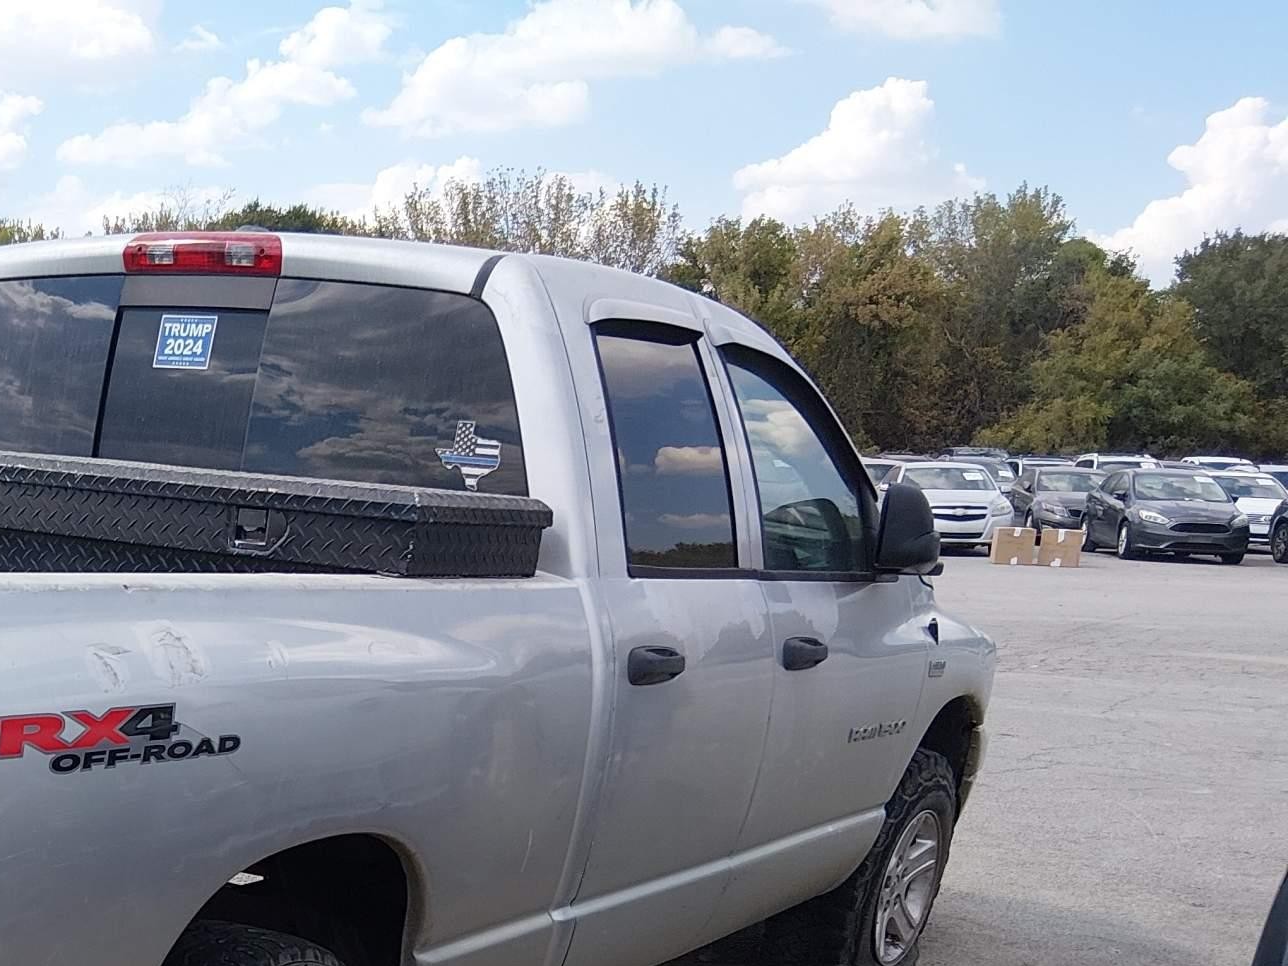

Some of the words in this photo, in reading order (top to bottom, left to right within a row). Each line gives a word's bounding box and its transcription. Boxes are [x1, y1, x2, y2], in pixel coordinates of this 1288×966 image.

[164, 323, 212, 337] TRUMP
[164, 338, 203, 356] 2024
[49, 734, 241, 775] OFF-ROAD
